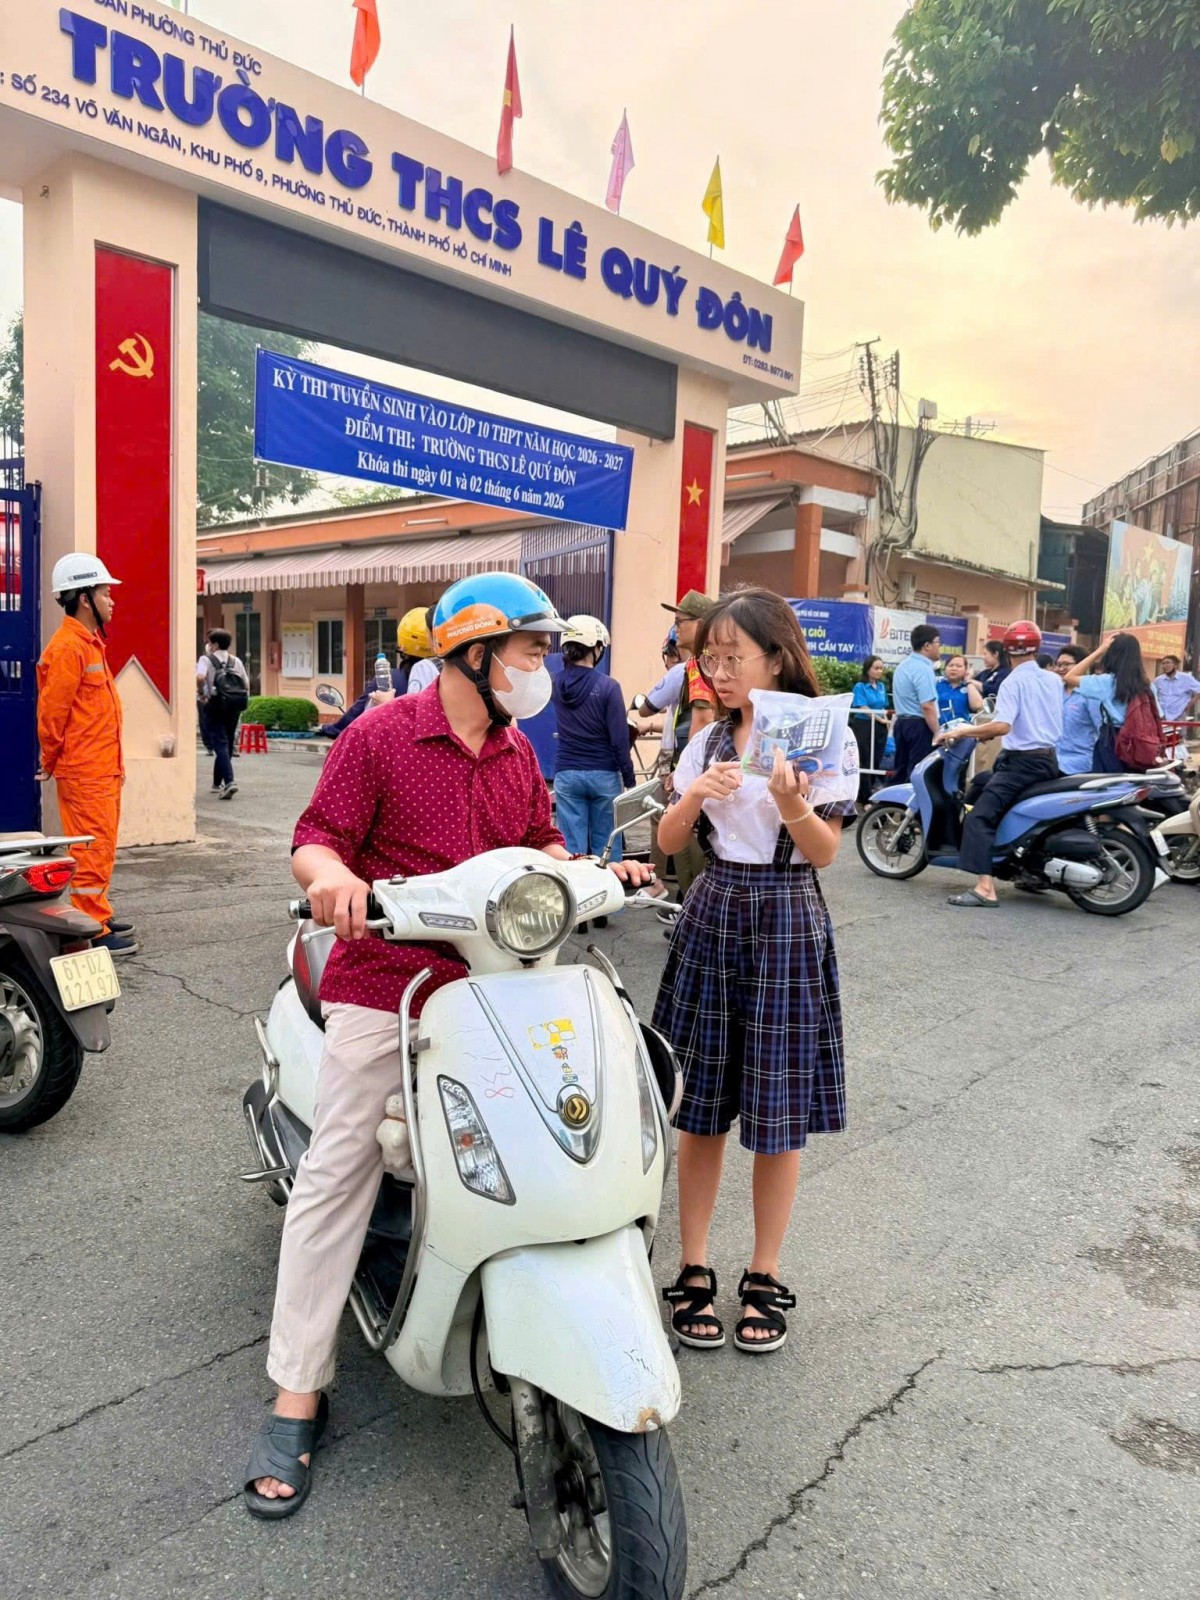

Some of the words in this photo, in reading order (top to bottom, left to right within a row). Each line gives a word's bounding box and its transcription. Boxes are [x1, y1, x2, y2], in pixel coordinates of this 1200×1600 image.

[131, 4, 195, 46] PHƯỜNG
[199, 35, 229, 61] THỦ
[232, 51, 262, 76] ĐỨC
[11, 73, 37, 96] SỐ
[41, 85, 71, 109] 234
[75, 98, 98, 119] VÕ
[102, 107, 133, 135] VĂN
[190, 142, 221, 166] KHU
[224, 156, 253, 177] PHỐ
[272, 173, 326, 206] PHƯỜNG
[329, 195, 354, 216] THỦ
[387, 217, 426, 244] THÀNH
[428, 234, 450, 252] PHỐ
[453, 241, 468, 260] HỒ
[470, 251, 487, 268] CHÍ
[489, 257, 512, 278] MINH
[59, 8, 373, 189] TRƯỜNG
[391, 151, 523, 251] THCS
[537, 216, 588, 281] LÊ
[600, 247, 688, 317] QUÝ
[695, 286, 773, 354] ĐÔN
[273, 366, 298, 391] KỲ
[301, 375, 328, 399] THI
[331, 382, 380, 412] TUYỂN
[383, 396, 416, 421] SINH
[420, 404, 447, 428] VÀO
[450, 412, 475, 435] LỚP
[478, 420, 490, 439] 10
[492, 424, 523, 446] THPT
[525, 431, 550, 454] NĂM
[552, 442, 576, 462] HỌC
[577, 446, 597, 466] 2026
[604, 453, 624, 471] 2027
[345, 413, 384, 443] ĐIỂM
[387, 426, 415, 450] THI:
[422, 435, 475, 463] TRƯỜNG
[478, 448, 509, 472] THCS
[511, 454, 526, 475] LÊ
[528, 460, 552, 481] QUÝ
[553, 464, 576, 487] ĐÔN
[357, 450, 389, 474] Khóa
[392, 459, 409, 479] thi
[411, 464, 438, 487] ngày
[440, 468, 452, 487] 01
[456, 473, 467, 491] và
[470, 475, 482, 493] 02
[484, 480, 512, 503] tháng
[513, 485, 520, 501] 6
[521, 488, 541, 506] năm
[543, 491, 565, 510] 2026
[838, 643, 854, 653] TAY
[64, 974, 113, 1006] 121.97
